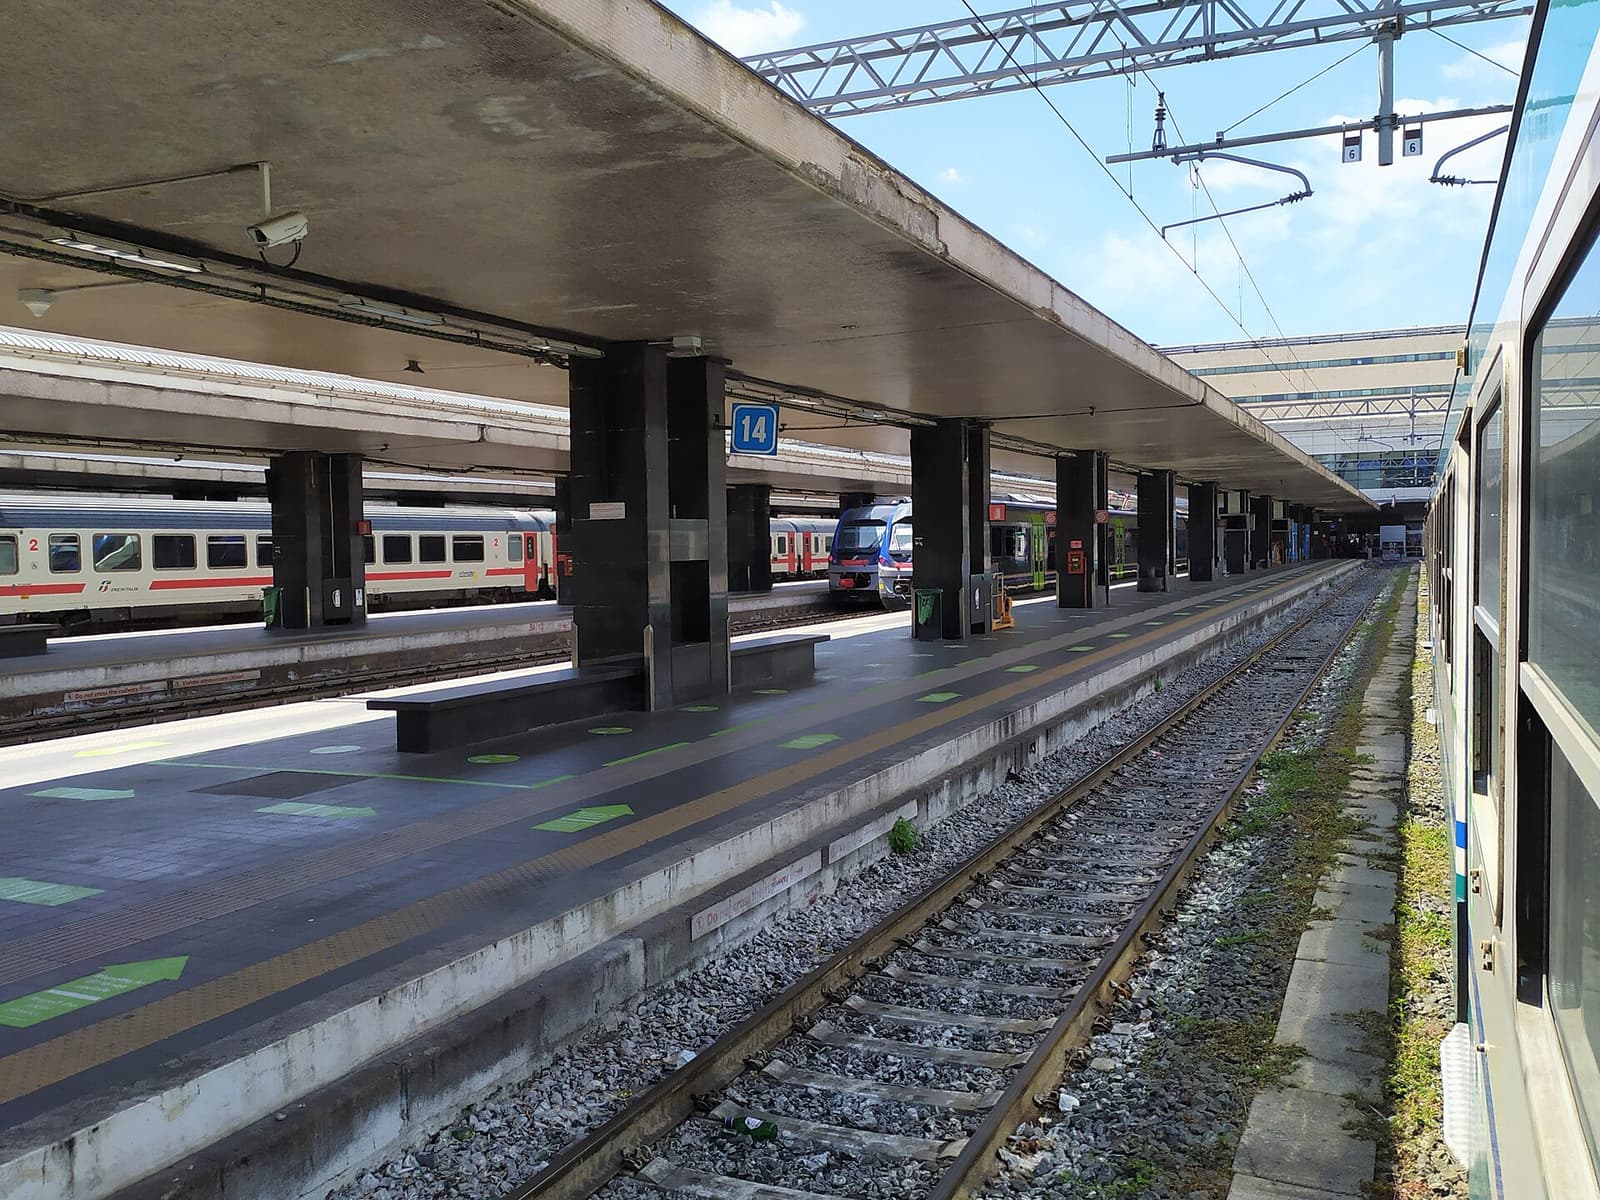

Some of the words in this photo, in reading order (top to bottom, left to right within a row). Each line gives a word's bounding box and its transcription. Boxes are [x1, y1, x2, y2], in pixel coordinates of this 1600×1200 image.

[1409, 142, 1416, 153] 6
[1349, 149, 1355, 159] 6
[742, 415, 767, 443] 14
[29, 539, 39, 551] 2
[493, 538, 500, 547] 2
[706, 911, 718, 924] Do
[732, 895, 753, 912] cross
